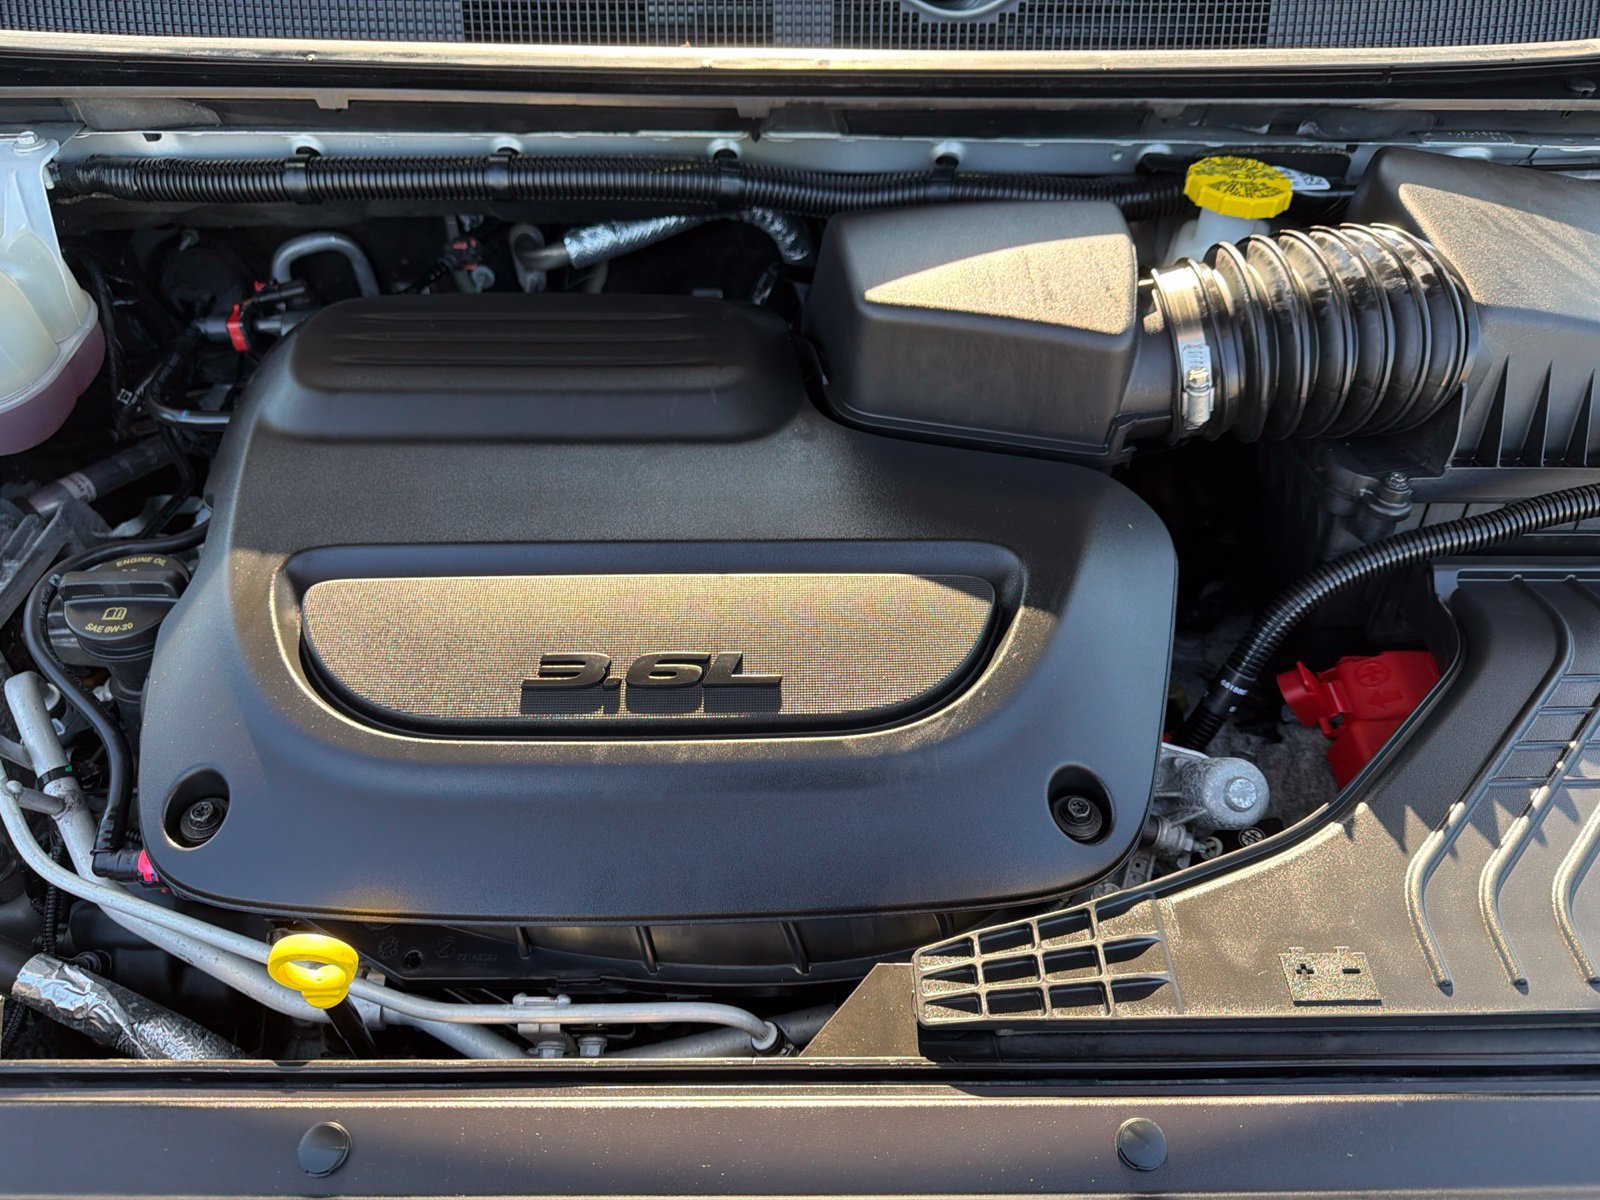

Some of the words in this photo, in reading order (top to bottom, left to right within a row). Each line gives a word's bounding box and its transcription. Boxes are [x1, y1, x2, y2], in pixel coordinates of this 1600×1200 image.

[116, 556, 153, 568] ENGINE
[85, 622, 104, 633] SAE
[104, 622, 134, 633] 0W-20
[520, 652, 783, 689] 3.6L
